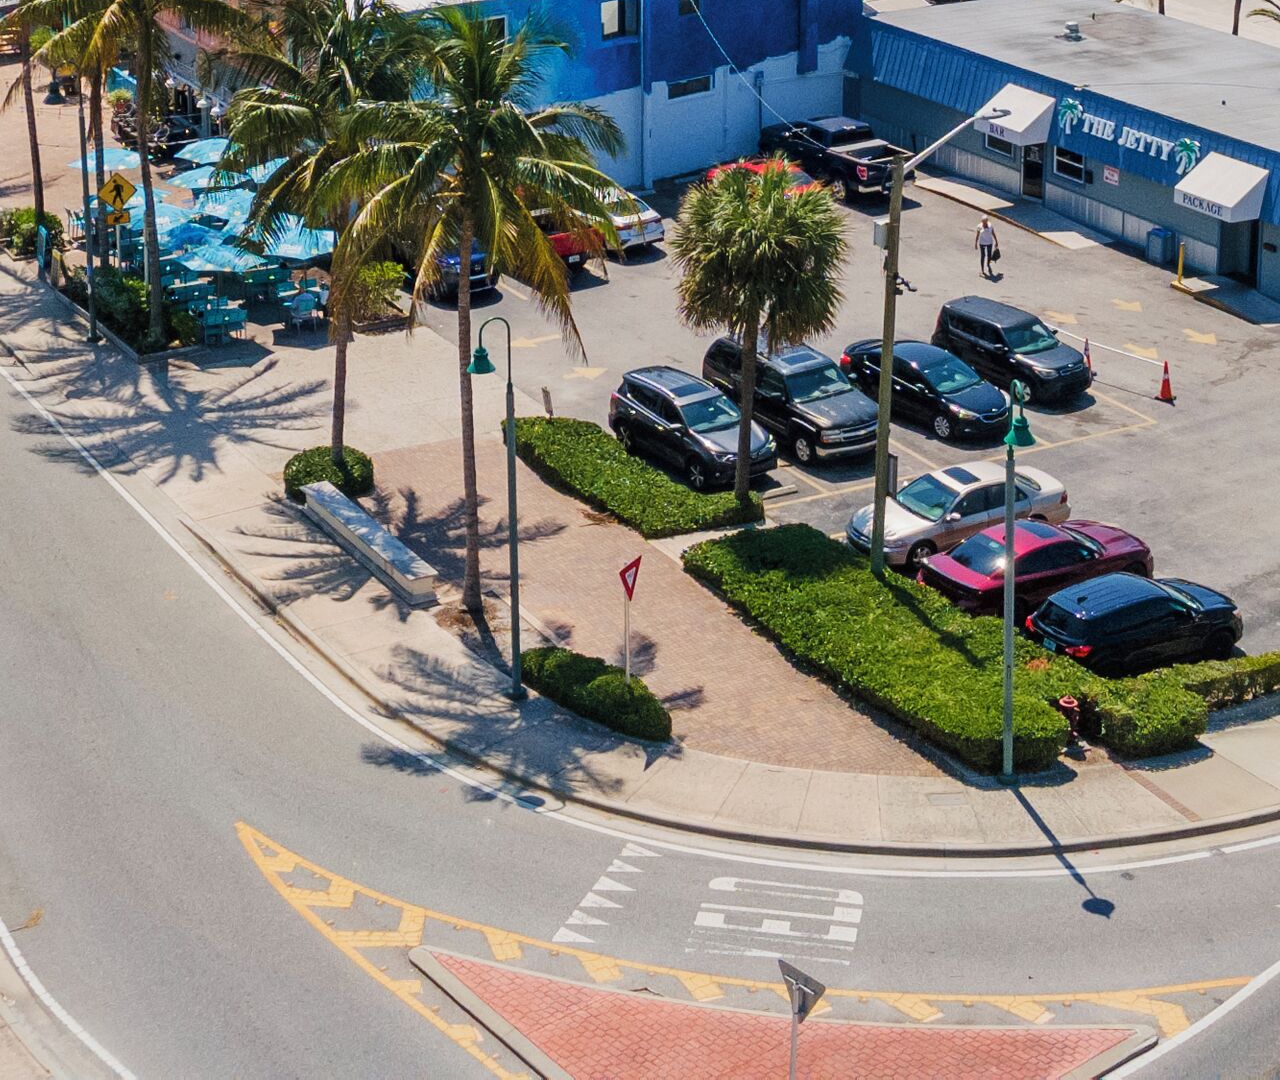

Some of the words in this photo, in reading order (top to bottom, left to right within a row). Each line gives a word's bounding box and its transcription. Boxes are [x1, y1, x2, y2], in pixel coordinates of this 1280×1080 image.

[989, 123, 1005, 138] BAR
[1082, 112, 1115, 141] THE
[1118, 127, 1175, 161] JETTY
[1182, 193, 1223, 217] PACKAGE
